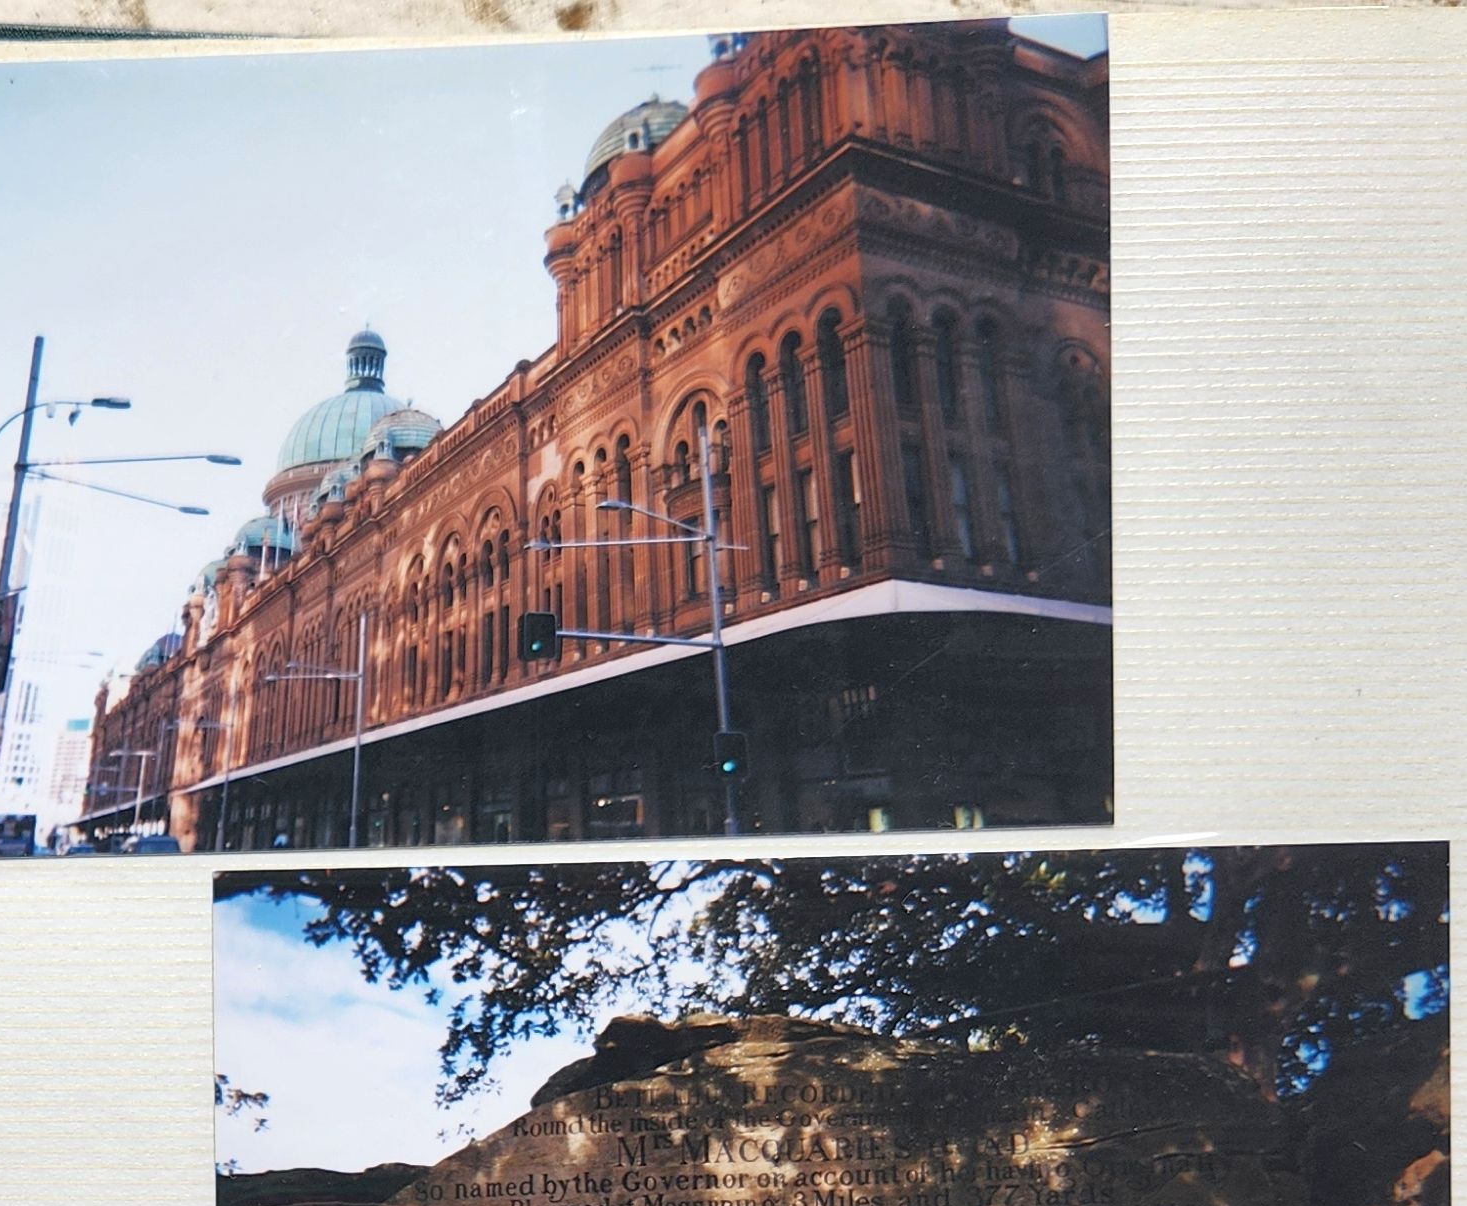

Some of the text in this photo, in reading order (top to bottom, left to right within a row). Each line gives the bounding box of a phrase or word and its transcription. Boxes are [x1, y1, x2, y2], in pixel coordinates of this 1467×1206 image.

[512, 1115, 582, 1138] Round
[589, 1112, 623, 1135] the
[414, 1181, 444, 1200] So
[454, 1173, 536, 1200] named
[543, 1173, 574, 1202] by
[576, 1171, 613, 1196] the
[621, 1169, 750, 1194] Governor
[757, 1172, 785, 1189] on
[795, 1163, 900, 1187] account
[906, 1163, 931, 1186] of
